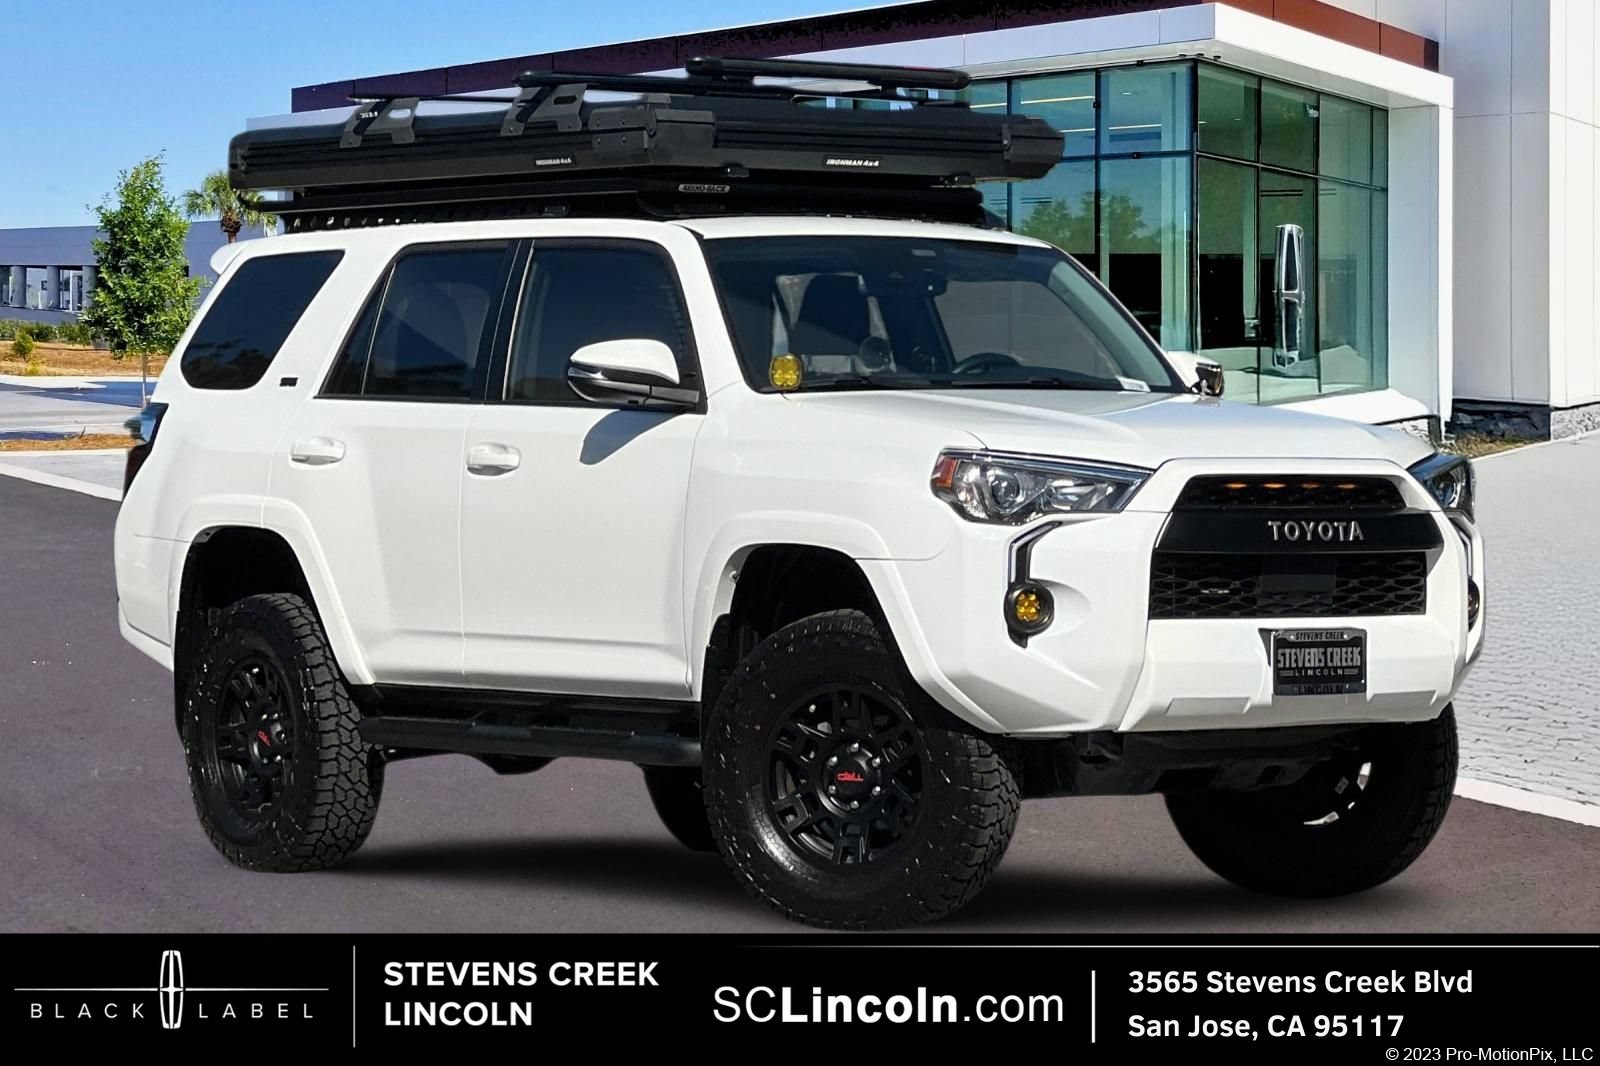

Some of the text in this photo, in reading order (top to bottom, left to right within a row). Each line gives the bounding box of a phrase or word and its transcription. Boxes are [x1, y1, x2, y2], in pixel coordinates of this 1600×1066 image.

[826, 158, 863, 166] IRONMAN
[1267, 520, 1364, 541] TOYOTA
[1295, 631, 1345, 640] STEVENS CREEK
[1277, 646, 1361, 668] STEVENS CREEK
[1295, 668, 1343, 676] LINCOLN
